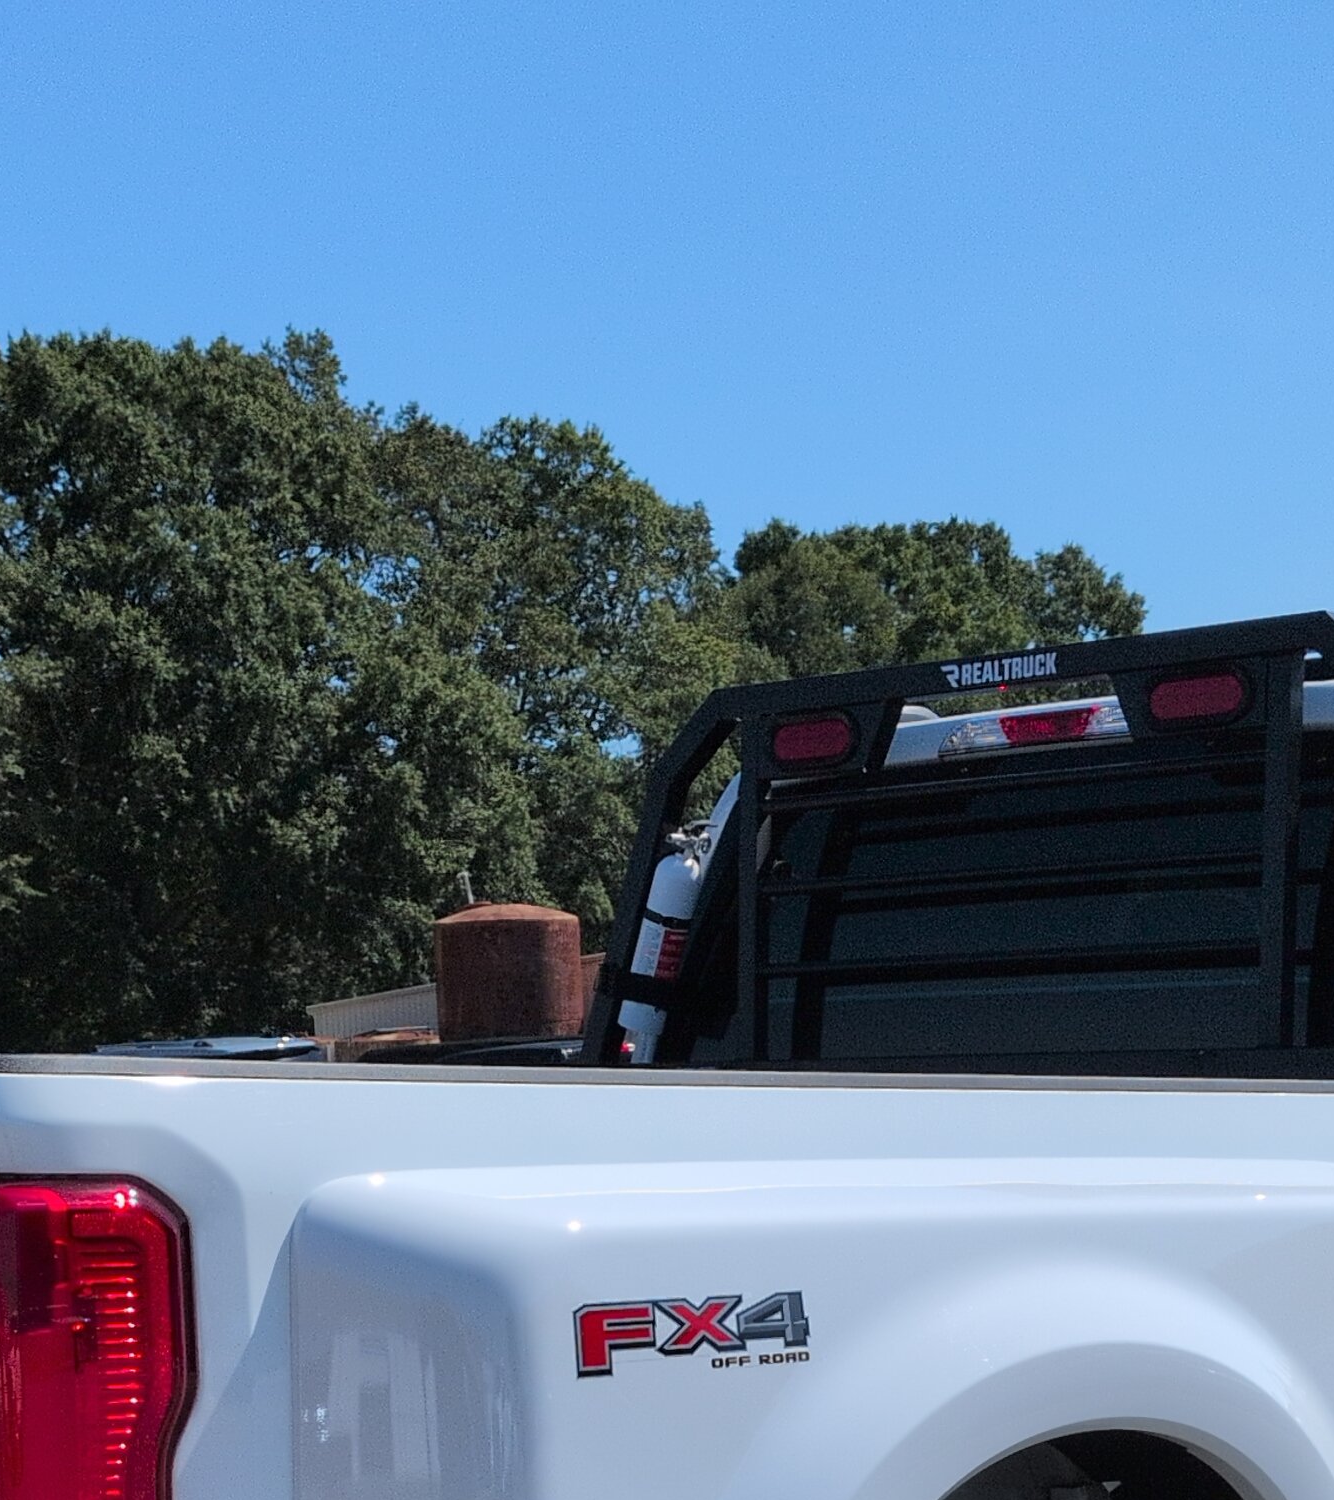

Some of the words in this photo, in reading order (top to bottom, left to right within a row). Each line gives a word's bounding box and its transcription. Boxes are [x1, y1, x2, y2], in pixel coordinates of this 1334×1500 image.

[961, 652, 1058, 686] REALTRUCK
[572, 1290, 811, 1379] FX4
[711, 1356, 752, 1369] OFF
[759, 1350, 810, 1366] ROAD
